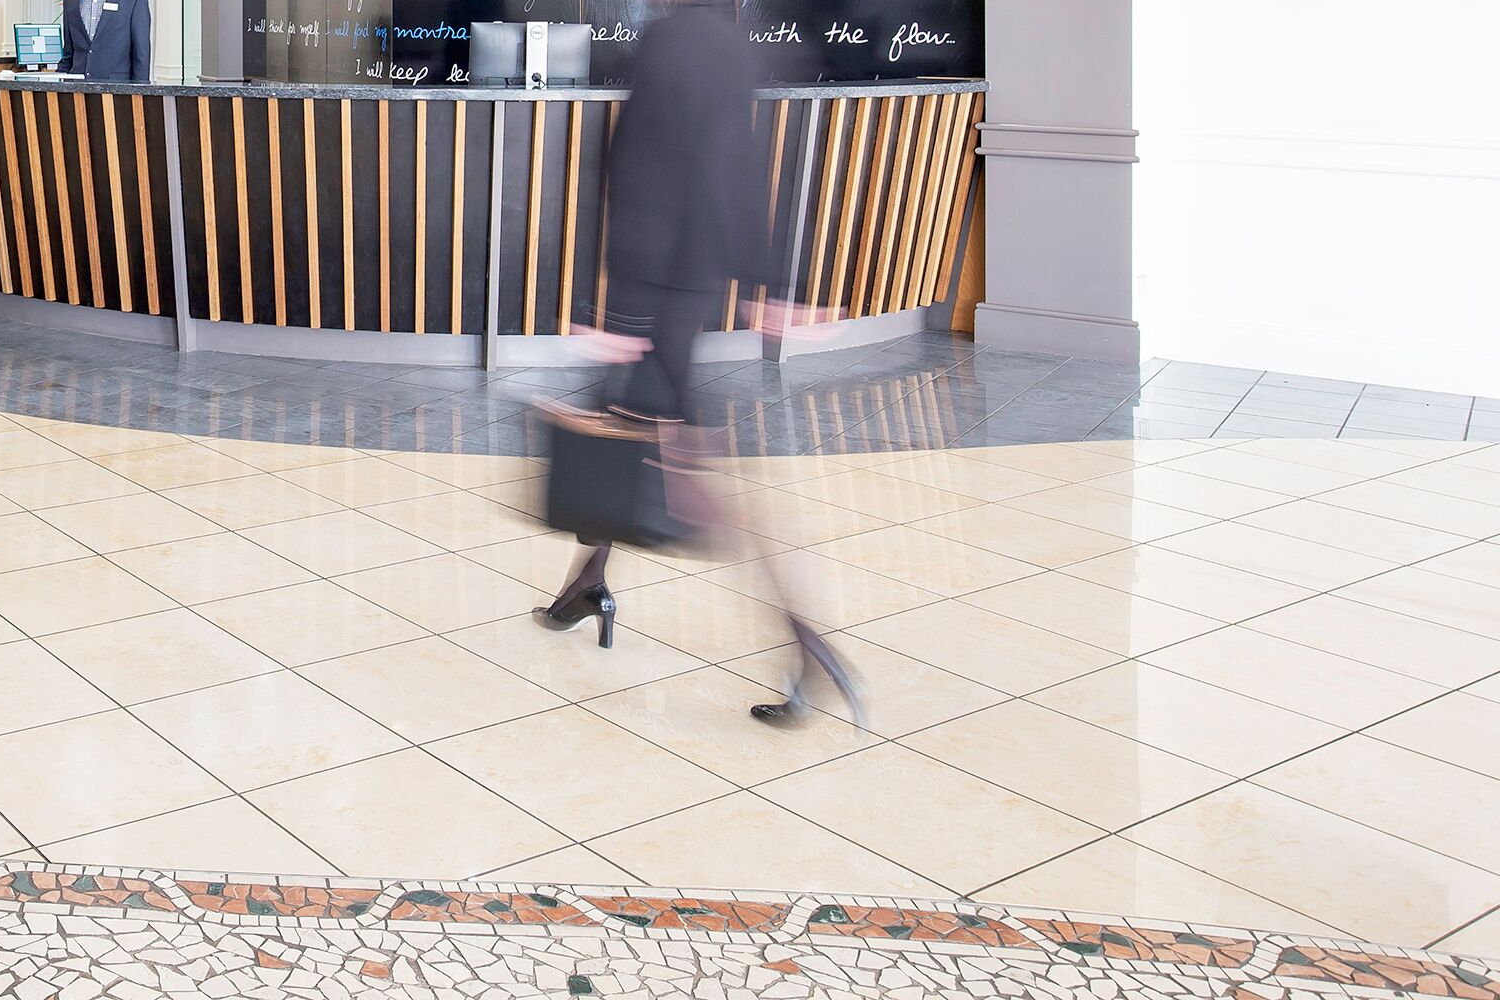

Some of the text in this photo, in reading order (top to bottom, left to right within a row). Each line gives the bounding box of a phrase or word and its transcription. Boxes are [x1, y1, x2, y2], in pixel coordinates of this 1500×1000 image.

[247, 18, 252, 32] I
[254, 18, 267, 34] will
[268, 18, 285, 35] think
[286, 20, 297, 46] for
[299, 19, 321, 48] myself
[334, 19, 350, 38] will
[352, 19, 370, 50] find
[374, 23, 388, 52] my
[749, 20, 802, 44] with
[823, 21, 869, 44] the
[355, 58, 361, 76] I
[366, 61, 384, 80] will
[388, 62, 429, 87] keep
